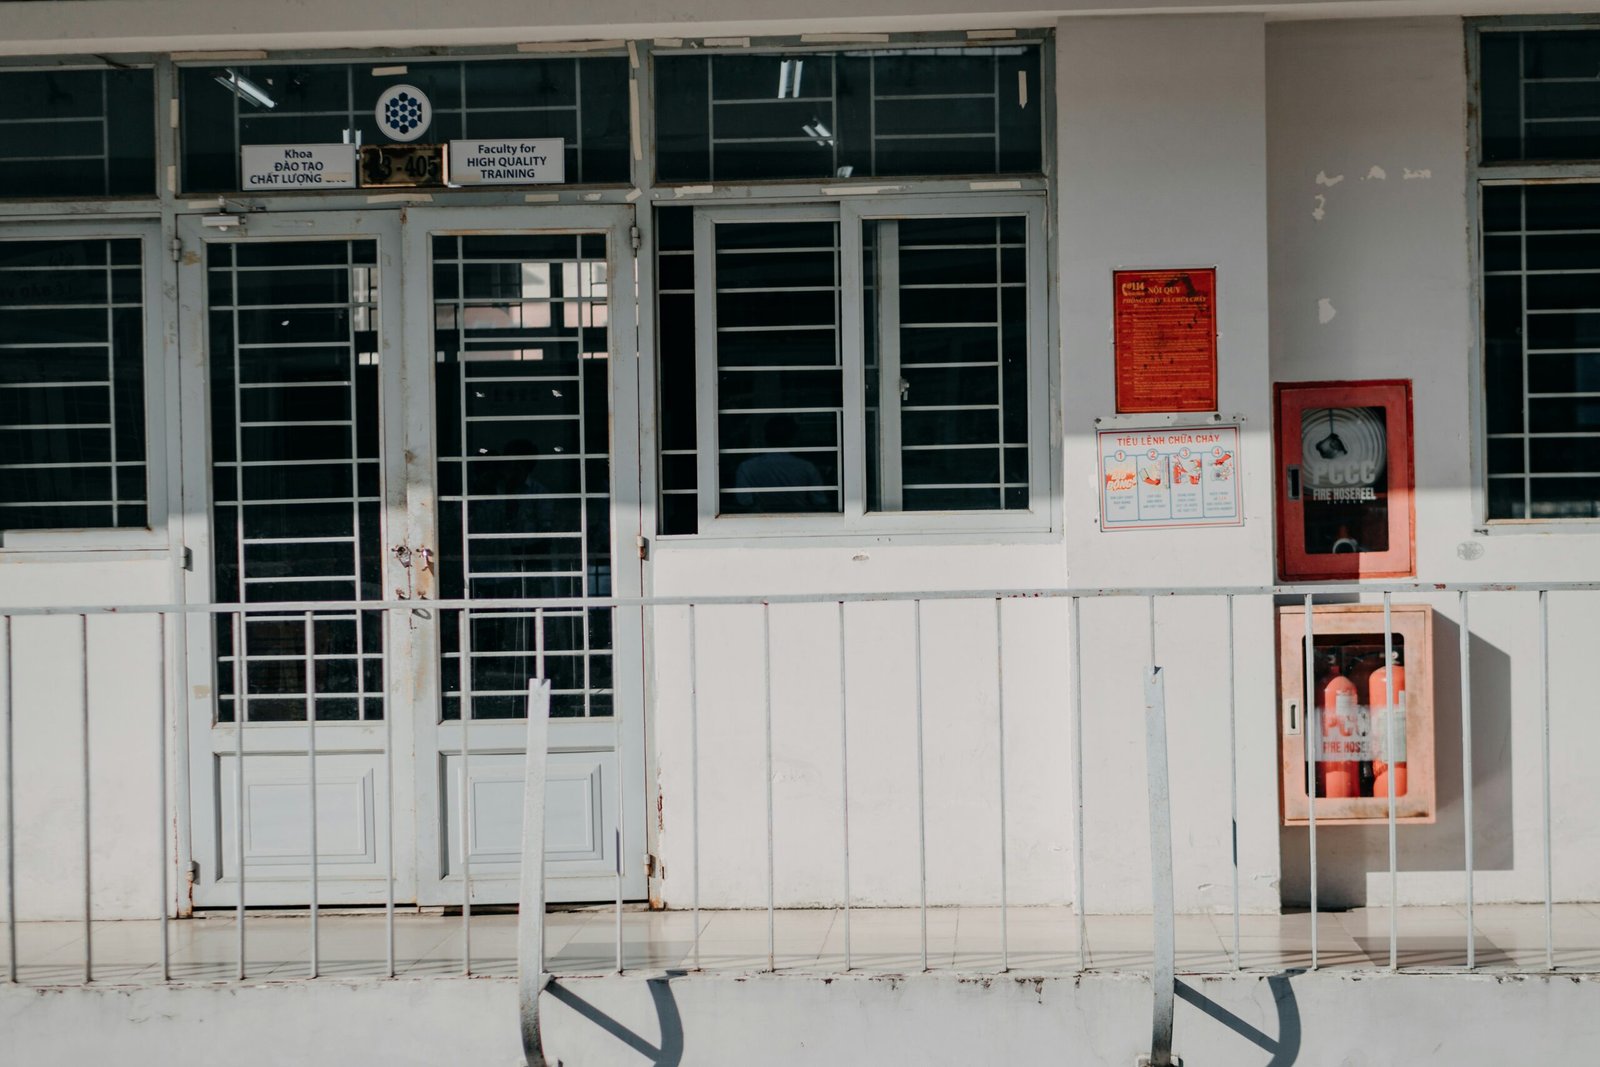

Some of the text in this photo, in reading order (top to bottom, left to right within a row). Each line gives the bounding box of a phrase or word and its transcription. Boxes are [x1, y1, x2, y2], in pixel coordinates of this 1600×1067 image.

[284, 149, 313, 159] Khoa
[478, 143, 536, 156] Faculty for
[274, 160, 324, 173] ĐÀO TẠO
[467, 156, 547, 167] HIGH QUALITY
[481, 169, 535, 179] TRAINING
[1312, 460, 1376, 485] PCCC
[1313, 487, 1332, 501] FIRE
[1323, 741, 1340, 754] FIRE
